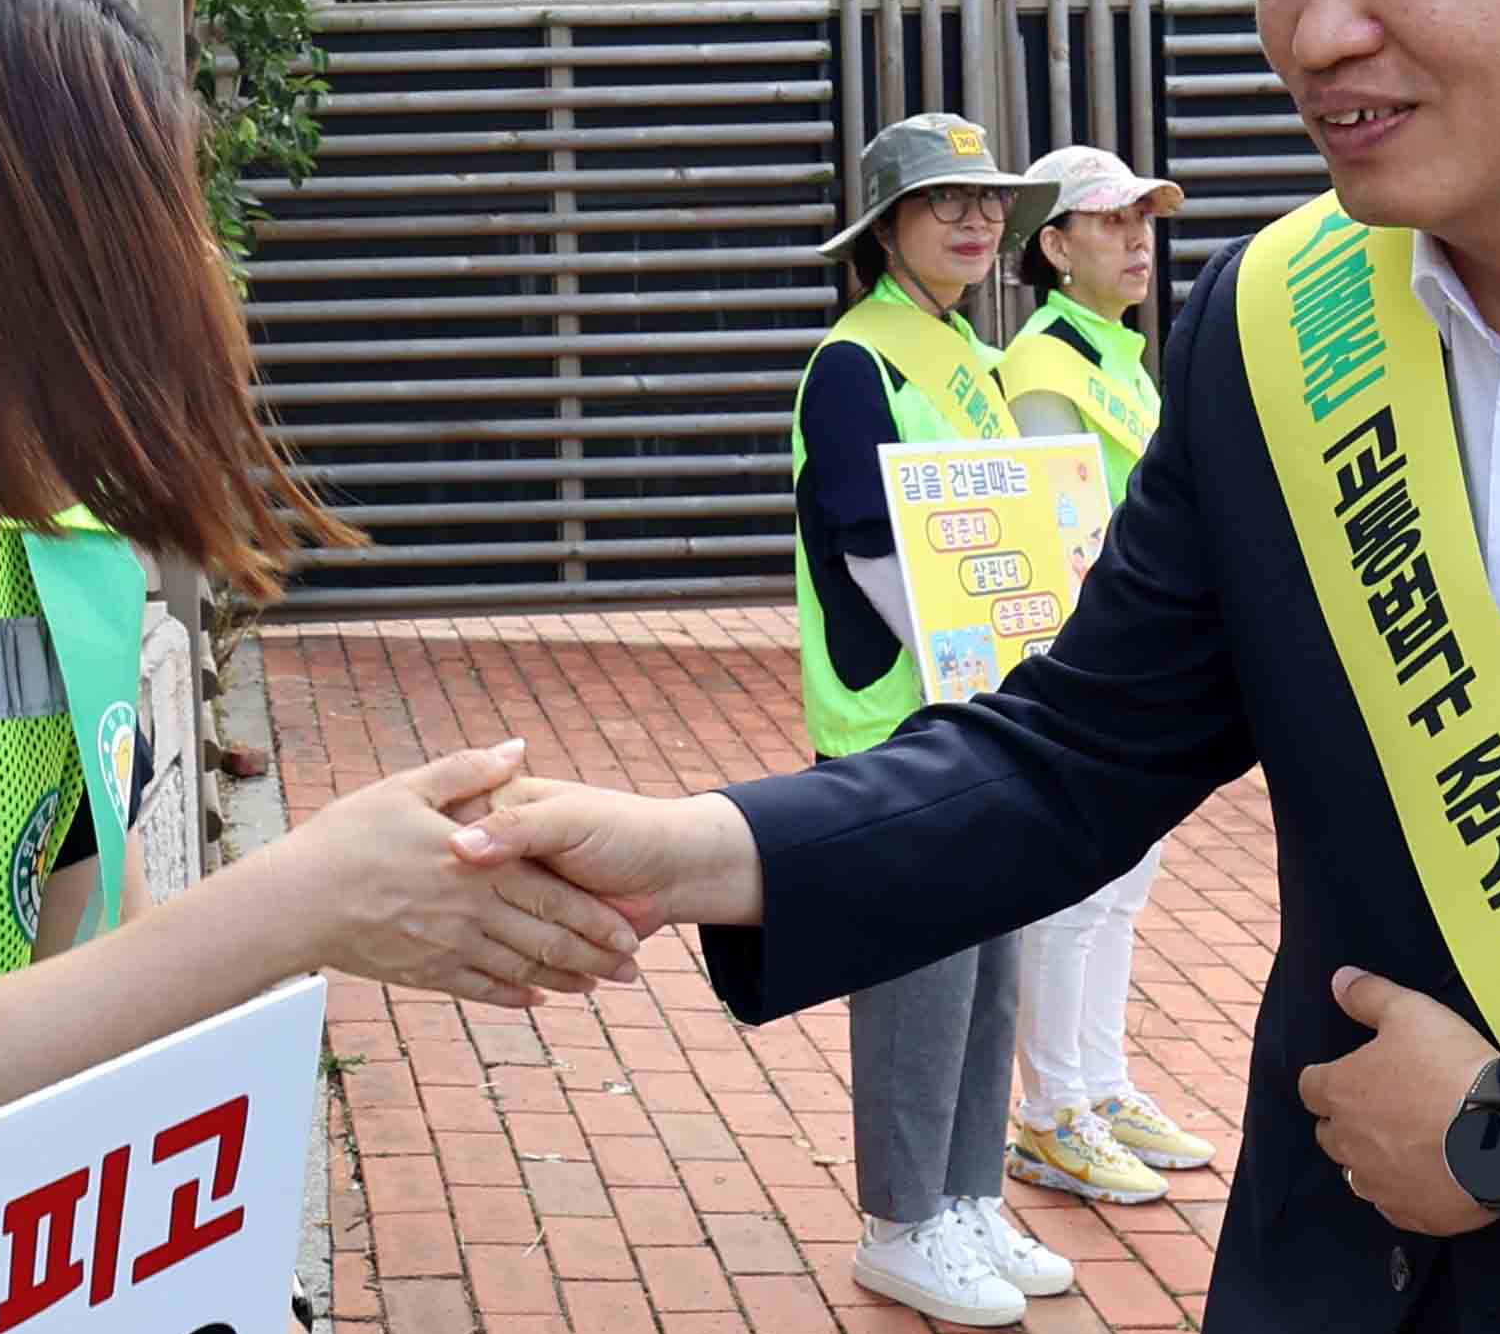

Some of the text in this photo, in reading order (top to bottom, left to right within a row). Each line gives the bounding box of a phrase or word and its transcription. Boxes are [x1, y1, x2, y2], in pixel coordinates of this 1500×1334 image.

[900, 464, 943, 501] 길을
[972, 559, 1021, 590] 살핀다
[1321, 404, 1477, 738] 교통법규
